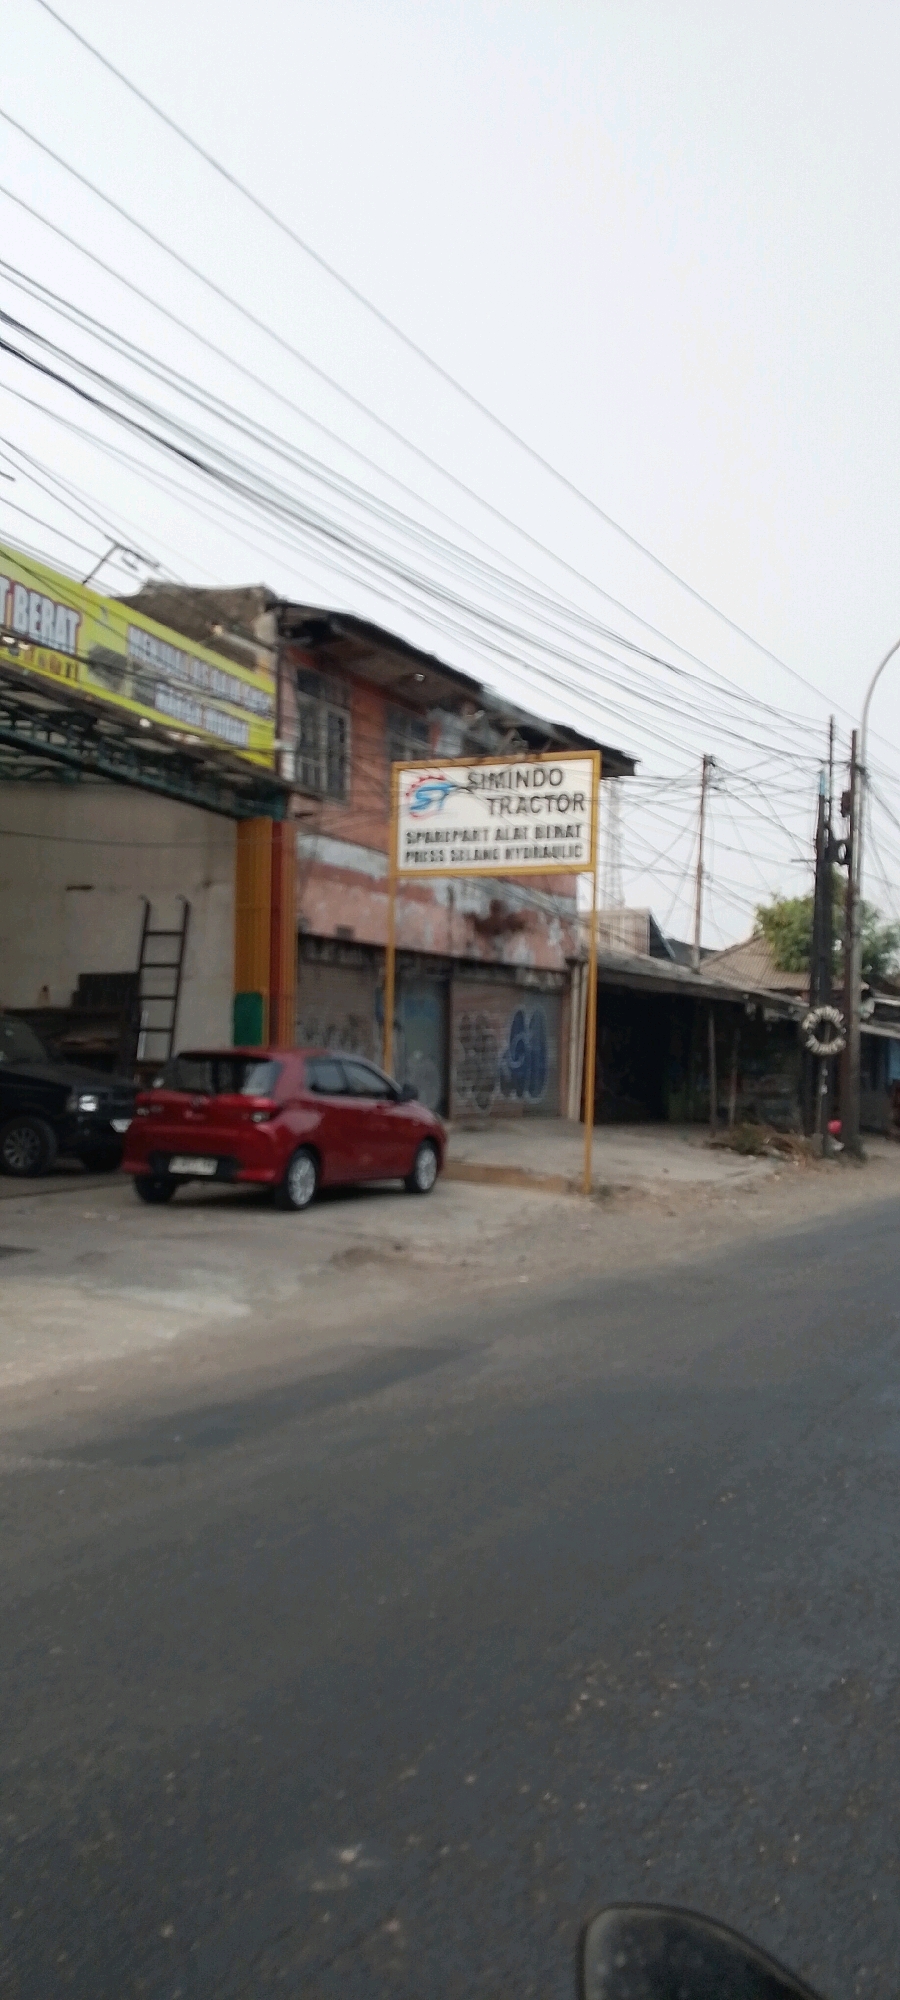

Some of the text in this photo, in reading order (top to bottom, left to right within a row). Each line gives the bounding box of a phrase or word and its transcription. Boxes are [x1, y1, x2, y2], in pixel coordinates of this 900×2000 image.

[13, 582, 81, 655] BERAT
[467, 767, 564, 789] SIMINDO
[486, 793, 586, 816] TRACTOR
[405, 823, 583, 845] SPAREPART ALAT BERAT
[505, 844, 584, 861] HYDRAULIC
